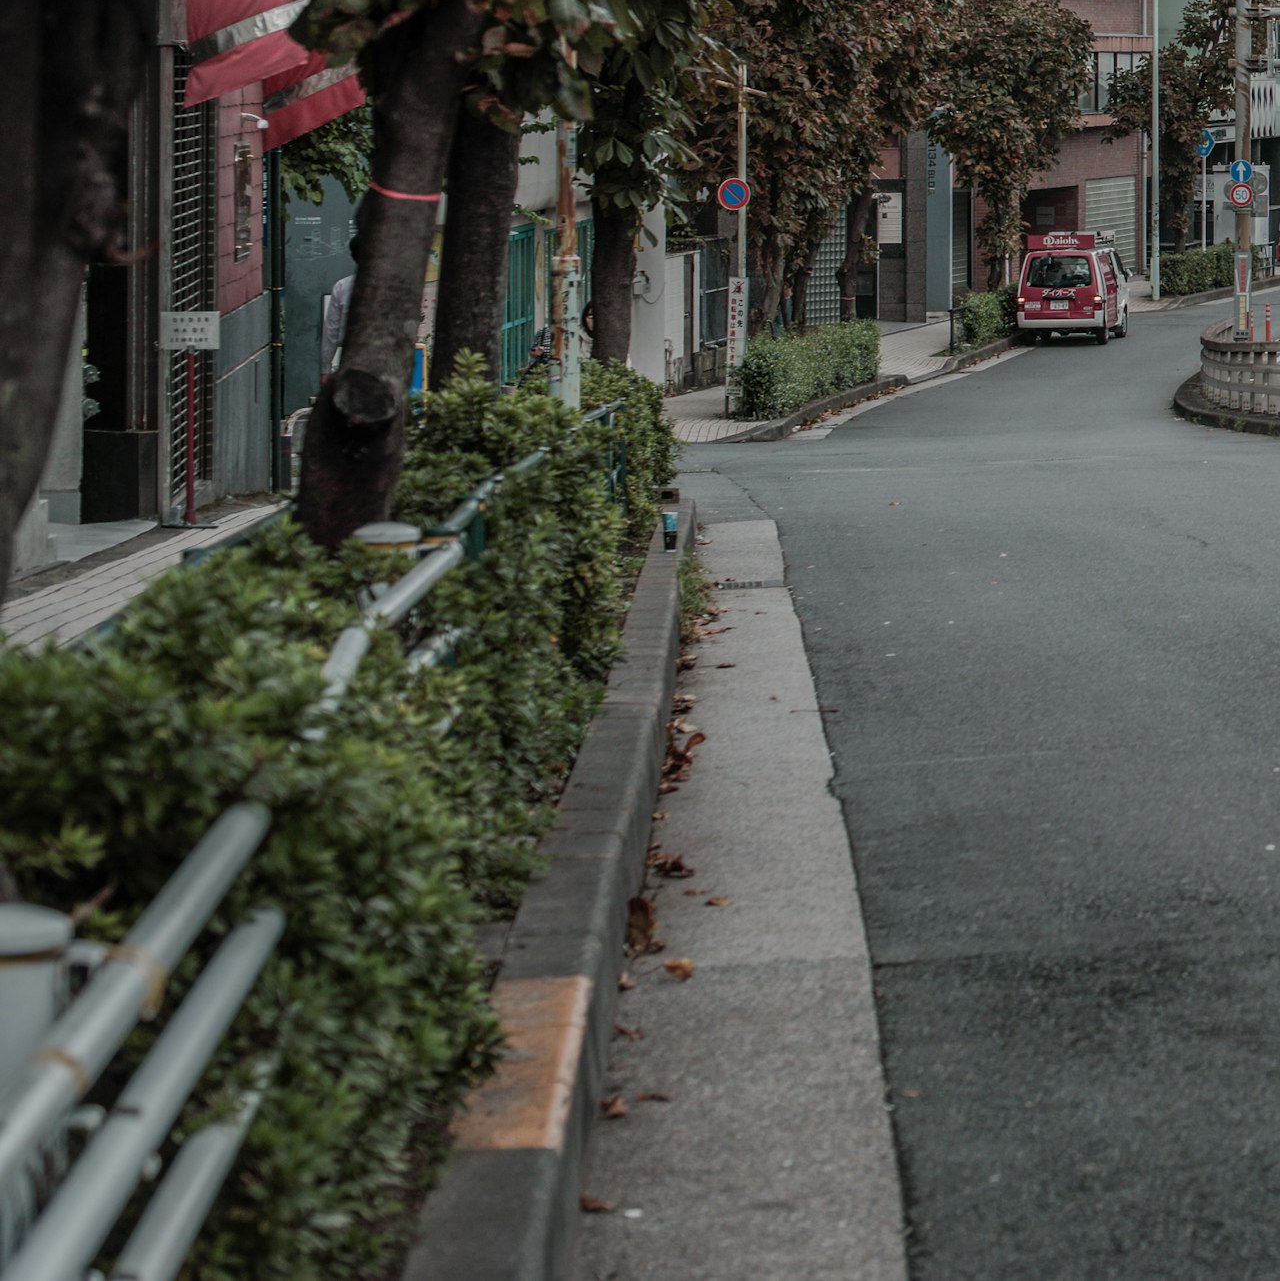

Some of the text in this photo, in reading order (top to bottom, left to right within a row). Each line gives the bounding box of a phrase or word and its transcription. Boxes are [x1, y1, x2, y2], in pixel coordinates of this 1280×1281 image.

[1235, 189, 1248, 200] 50
[1042, 235, 1078, 245] Daiohs
[1042, 288, 1076, 296] ダイオーズ
